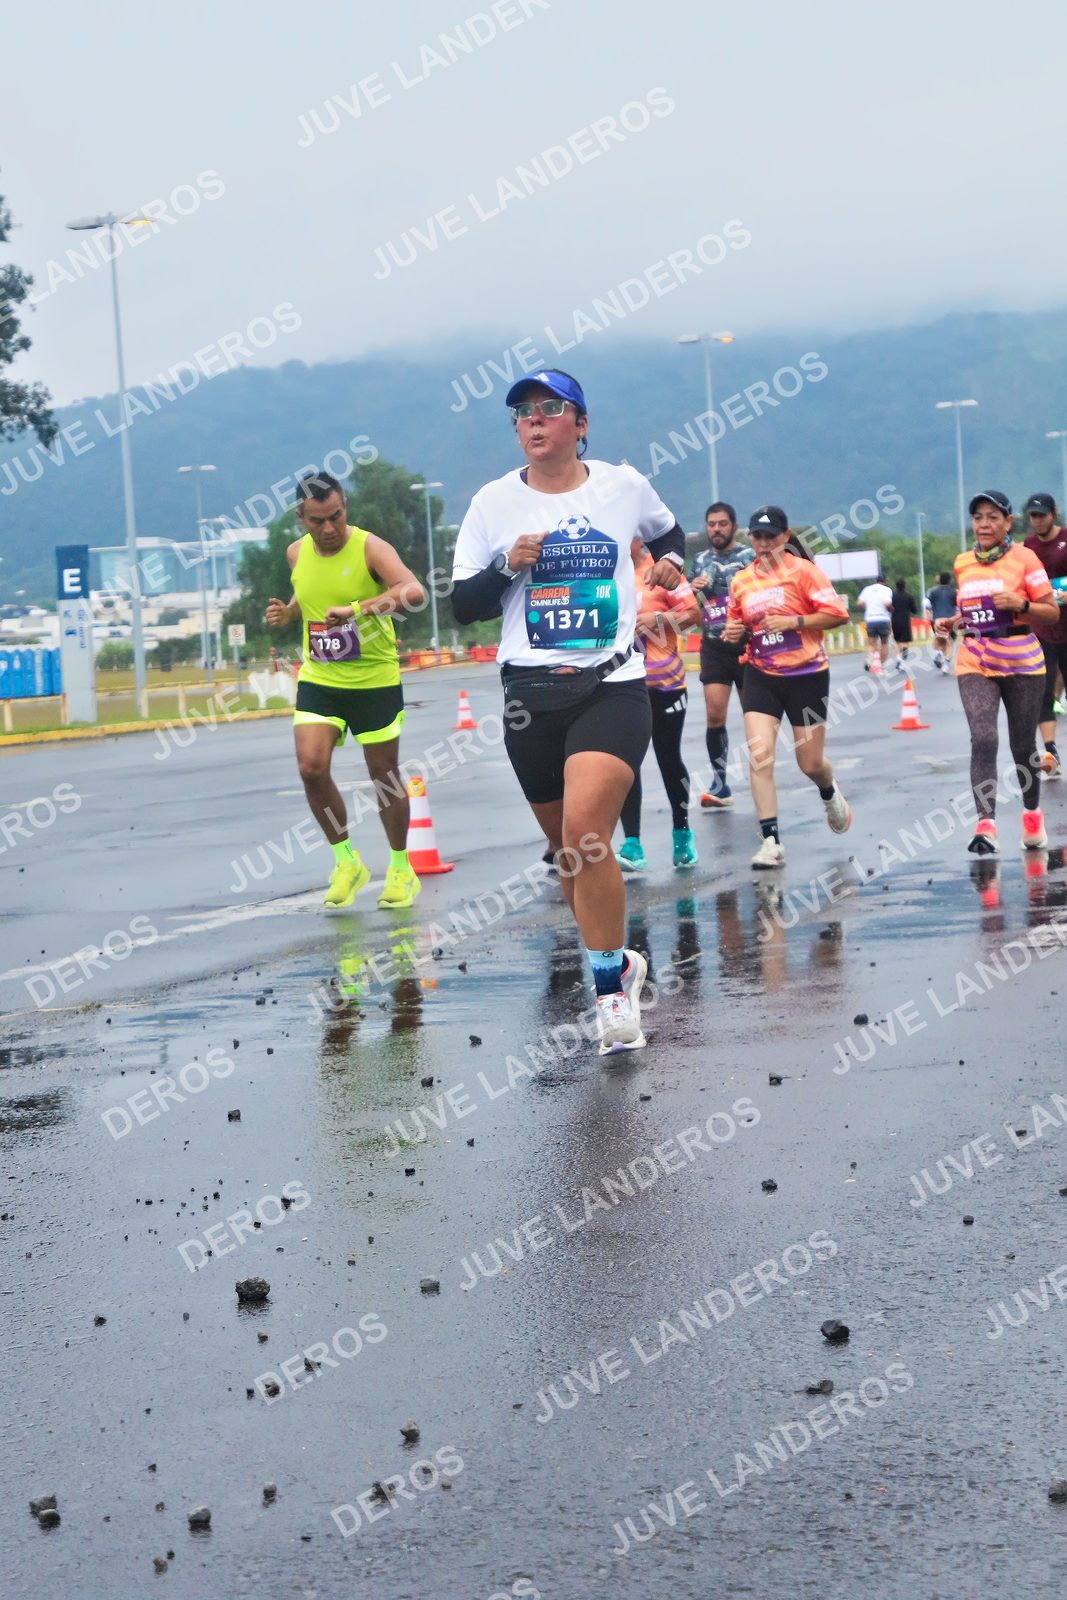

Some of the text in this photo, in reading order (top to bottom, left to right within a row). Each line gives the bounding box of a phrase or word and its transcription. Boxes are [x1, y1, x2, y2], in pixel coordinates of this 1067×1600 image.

[542, 545, 610, 557] ESCUELA
[535, 556, 614, 572] DE FÚTBOL
[63, 568, 82, 593] E
[530, 586, 570, 599] CARRERA
[596, 585, 611, 598] 10K
[544, 608, 599, 630] 1371
[971, 609, 995, 623] 322
[317, 638, 341, 650] 178
[761, 632, 785, 646] 486
